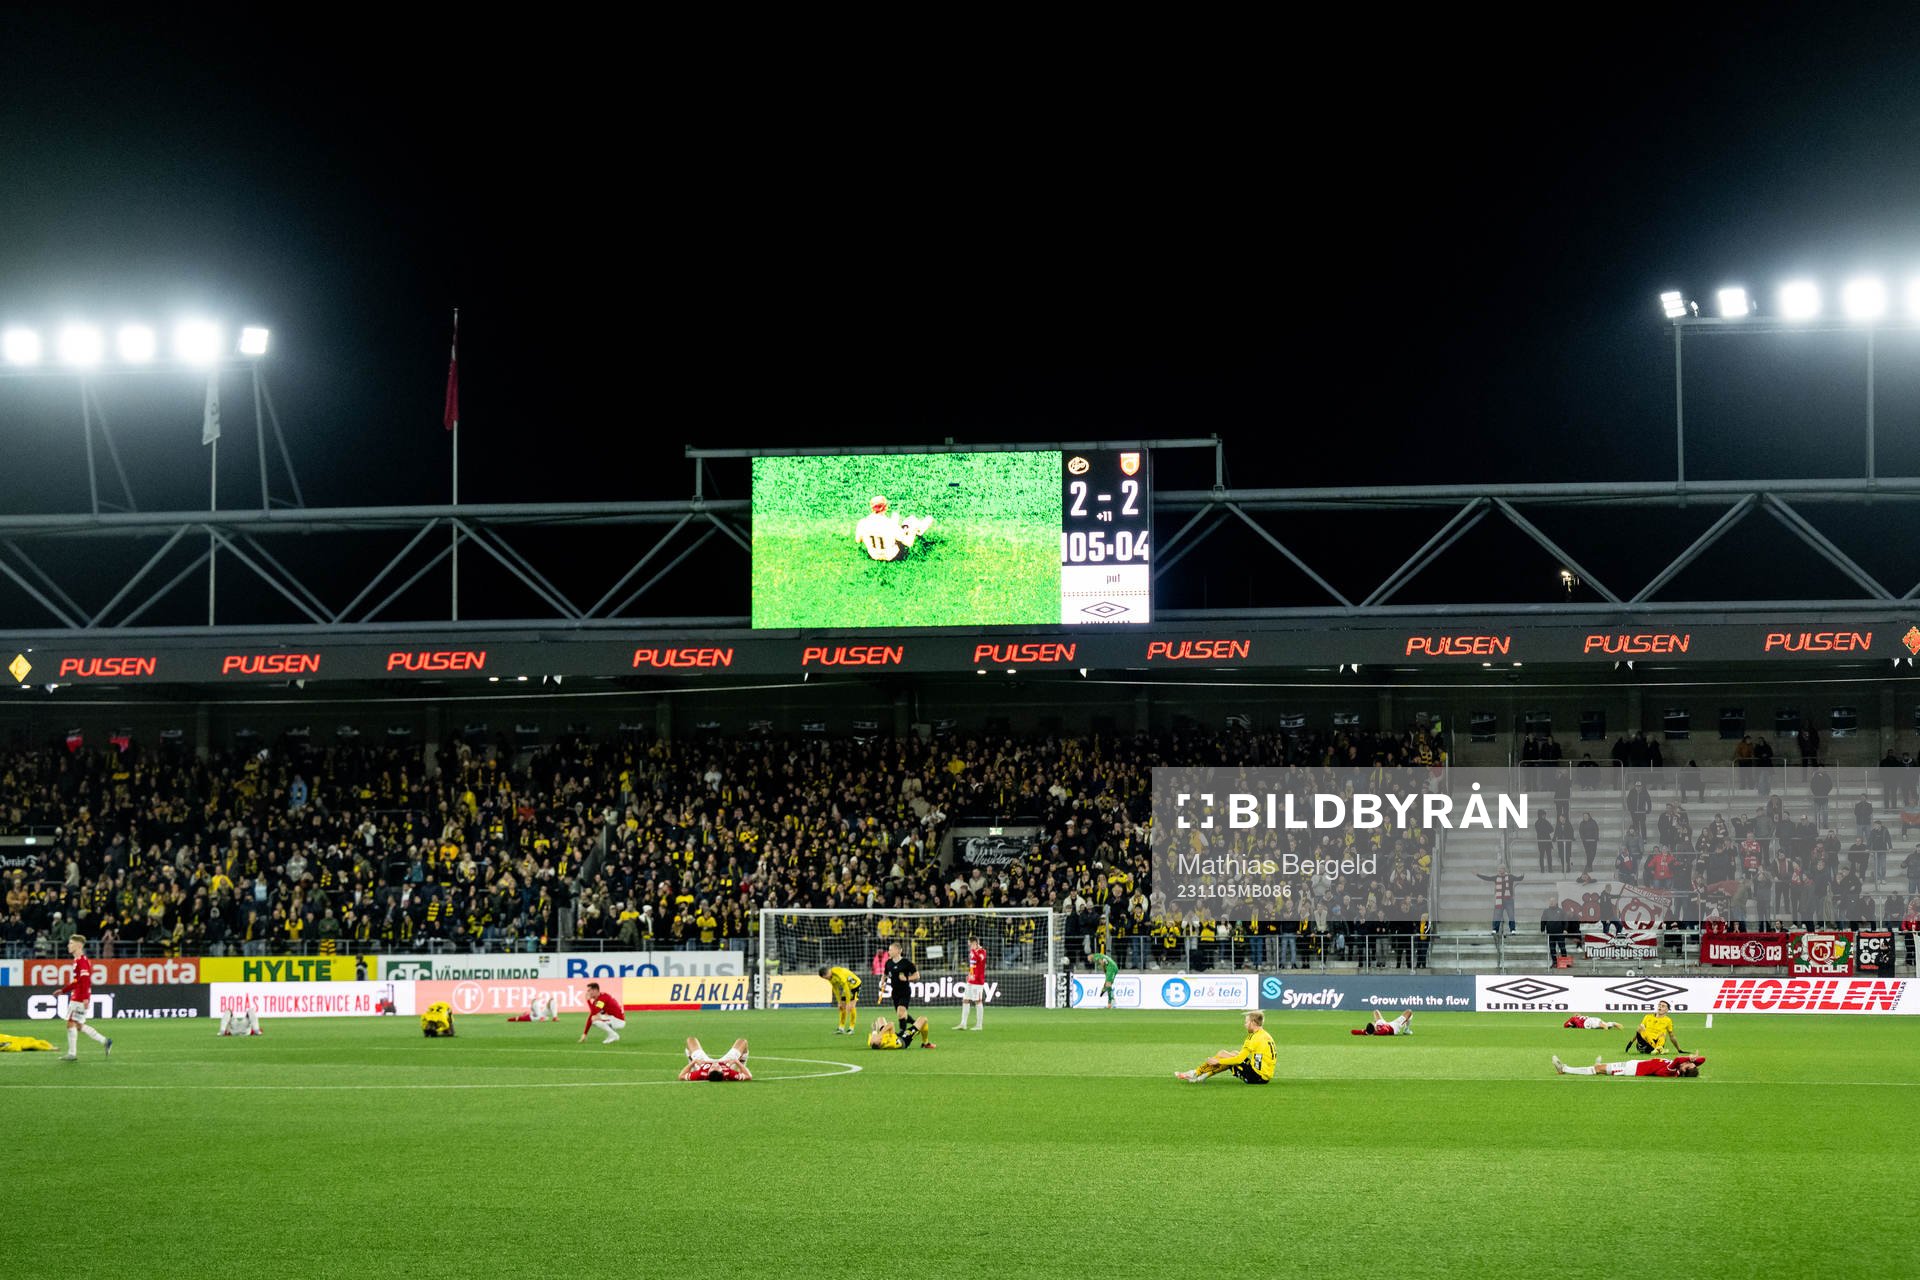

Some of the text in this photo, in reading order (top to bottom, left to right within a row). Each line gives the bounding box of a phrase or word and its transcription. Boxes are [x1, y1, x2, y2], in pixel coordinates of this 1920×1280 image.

[1070, 481, 1087, 516] 2
[1121, 480, 1139, 515] 2
[1096, 511, 1112, 522] +11
[870, 535, 886, 549] 11
[1147, 639, 1251, 660] PULSEN
[1406, 636, 1511, 656] PULSEN
[1584, 634, 1690, 653] PULSEN
[1765, 632, 1873, 651] PULSEN
[387, 652, 487, 671] PULSEN
[633, 648, 734, 667] PULSEN
[802, 646, 904, 665] PULSEN
[974, 643, 1077, 662] PULSEN
[59, 657, 157, 677] PULSEN
[222, 654, 321, 674] PULSEN
[1766, 945, 1781, 960] 03
[31, 964, 108, 985] rena
[119, 960, 197, 985] renta
[243, 960, 331, 982] HYLTE
[567, 956, 735, 979] Borohus
[1794, 964, 1849, 974] ON TOUR
[1218, 987, 1242, 997] tele
[1282, 988, 1345, 1009] Syncify
[1400, 995, 1423, 1006] with
[1425, 995, 1444, 1006] the
[1446, 995, 1470, 1006] flow
[1713, 980, 1902, 1010] MOBILEN
[220, 992, 370, 1013] BORÅS TRUCKSERVICE AB
[116, 1008, 198, 1018] ATHLETICS
